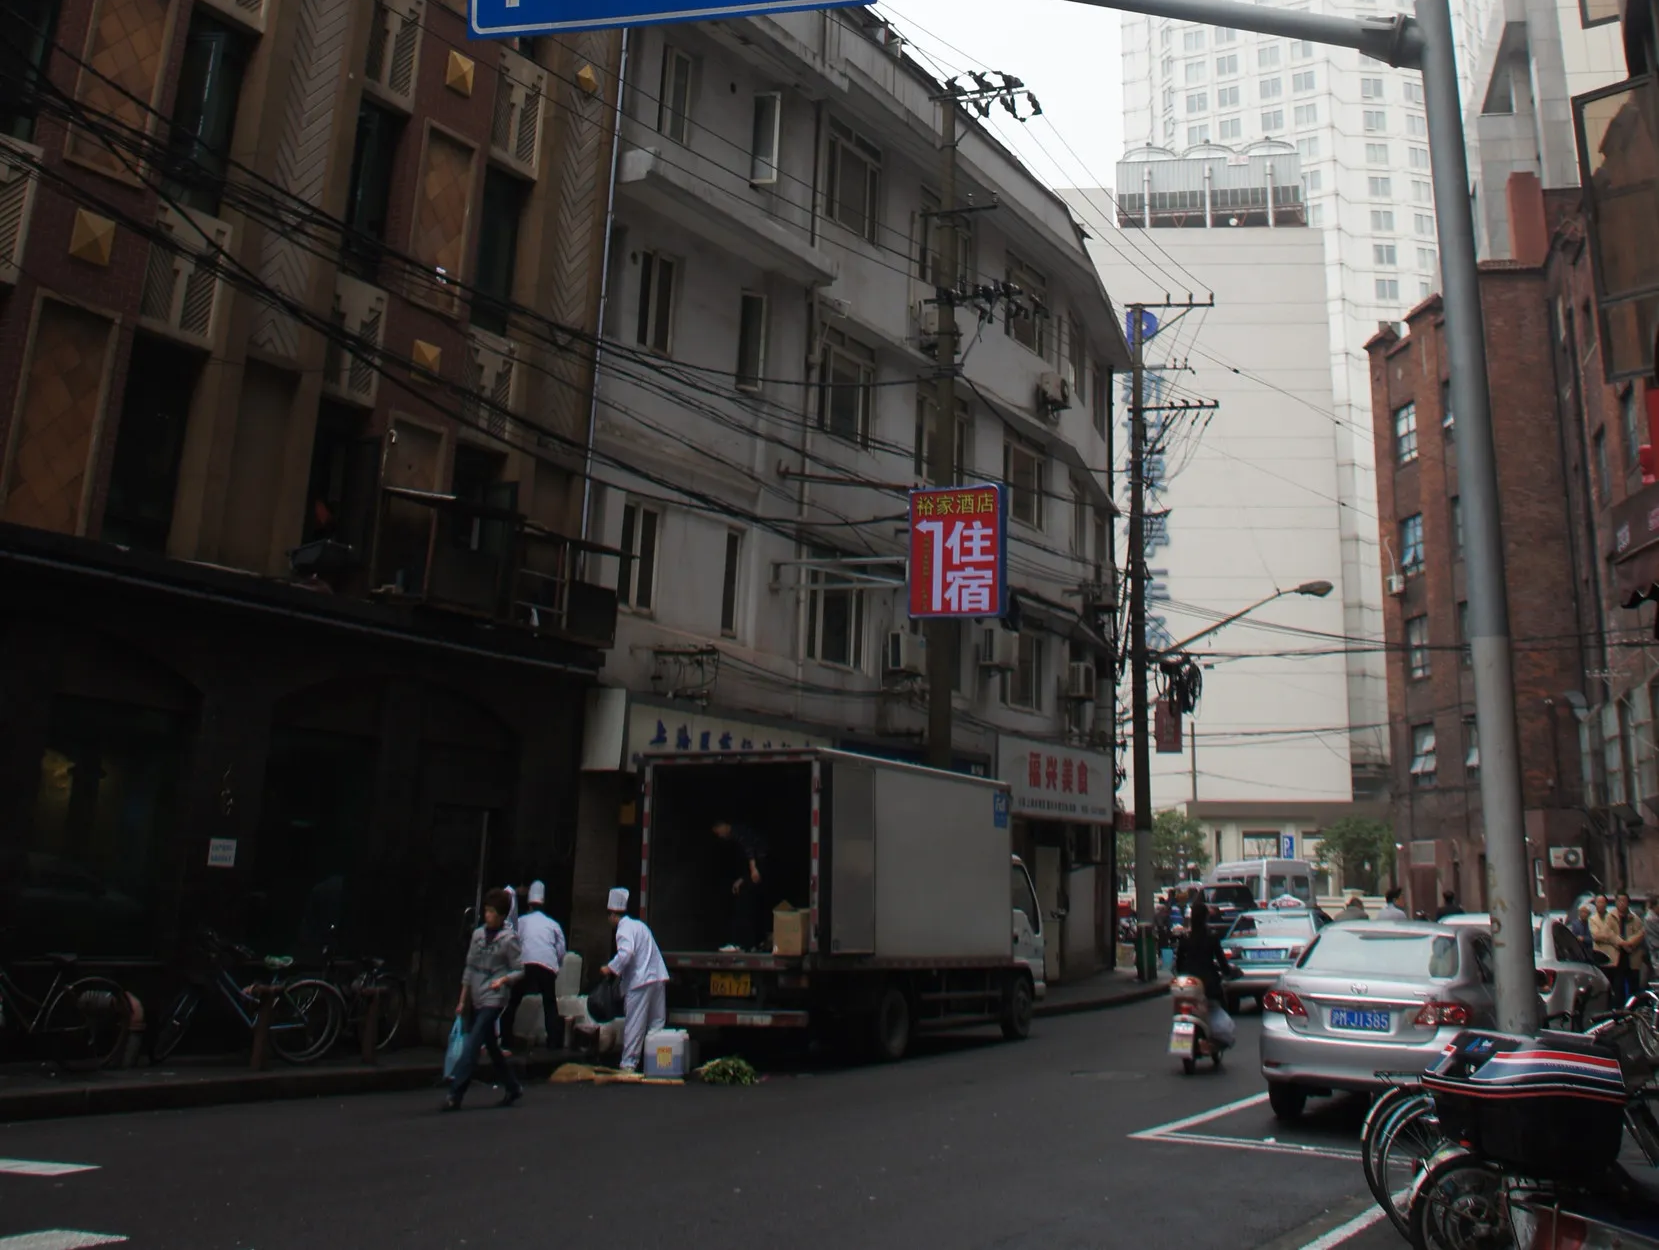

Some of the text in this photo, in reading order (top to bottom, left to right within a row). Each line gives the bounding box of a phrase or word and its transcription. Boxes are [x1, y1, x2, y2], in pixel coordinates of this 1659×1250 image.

[916, 493, 994, 516] 裕家酒店
[944, 520, 994, 612] 住宿
[1028, 751, 1088, 794] 福兴美食
